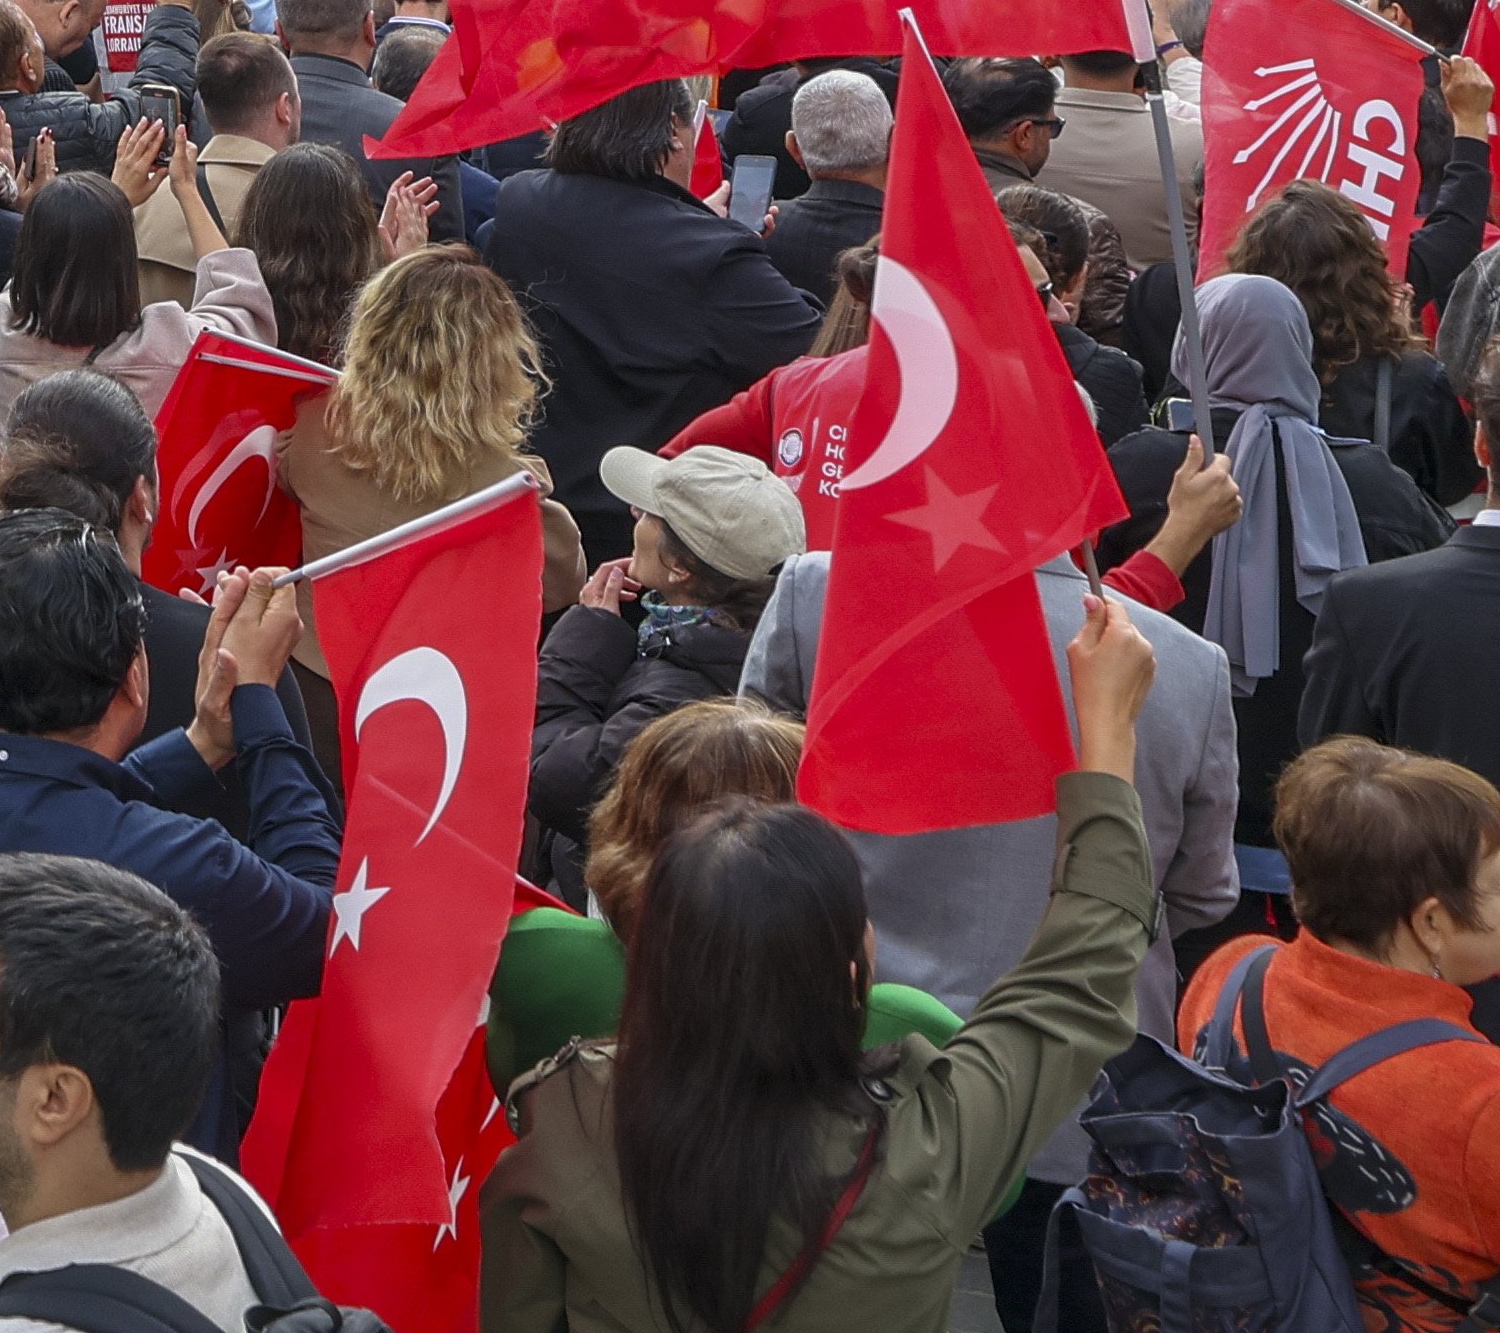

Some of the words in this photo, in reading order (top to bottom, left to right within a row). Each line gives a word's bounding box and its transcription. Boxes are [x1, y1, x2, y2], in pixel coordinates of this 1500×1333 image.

[104, 15, 147, 35] FRANS
[106, 37, 141, 52] LORRAI
[1340, 99, 1406, 242] CH
